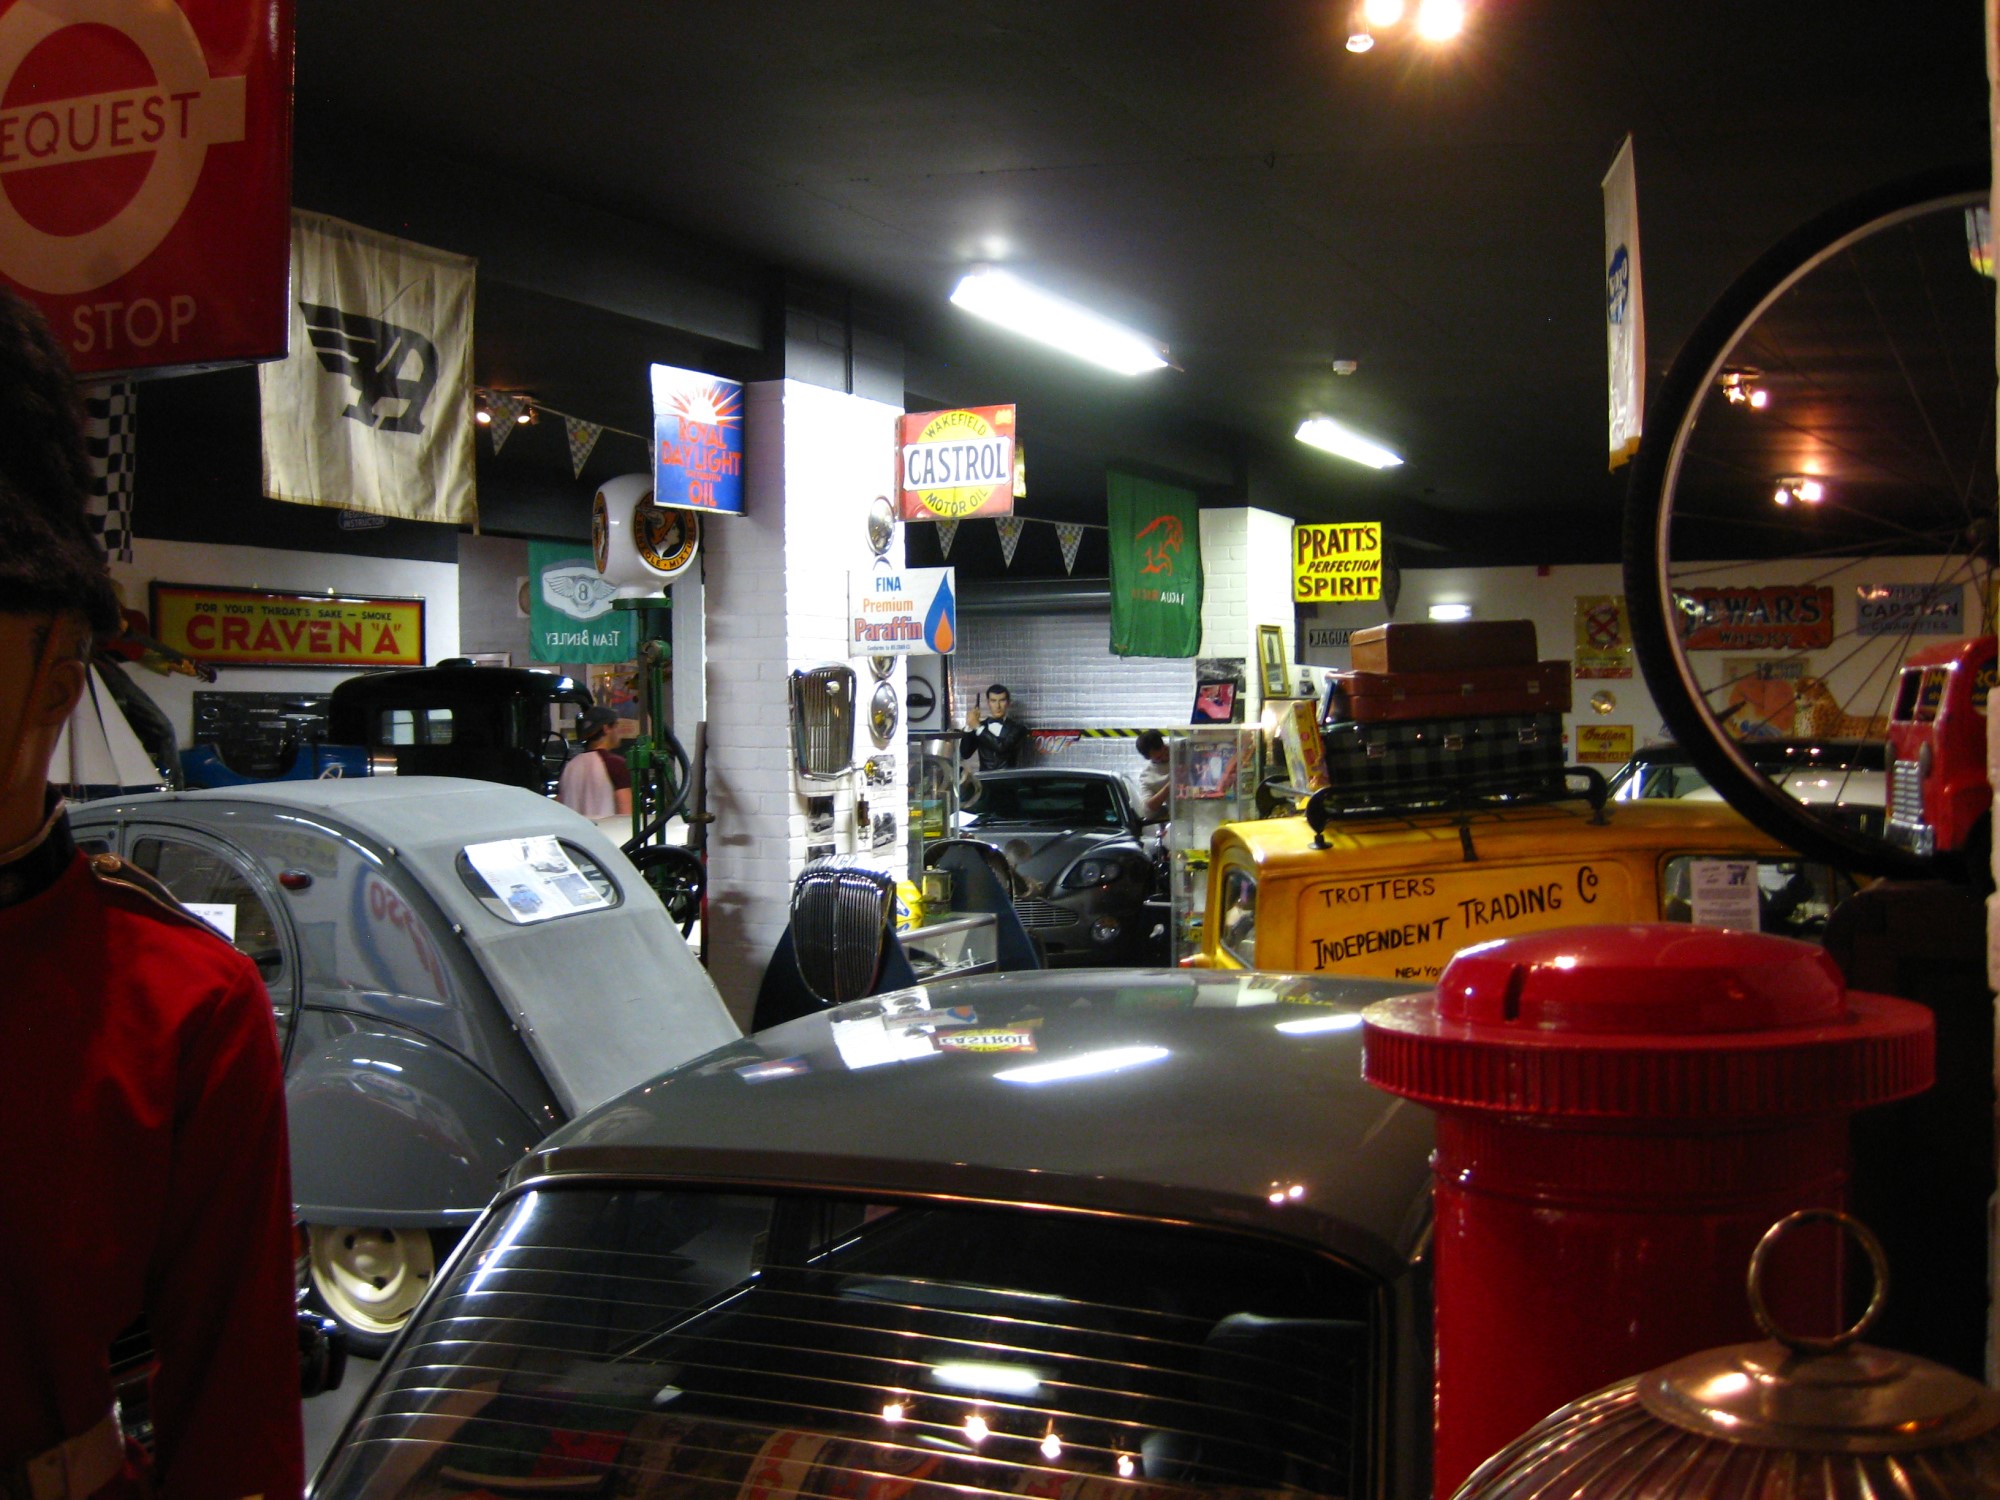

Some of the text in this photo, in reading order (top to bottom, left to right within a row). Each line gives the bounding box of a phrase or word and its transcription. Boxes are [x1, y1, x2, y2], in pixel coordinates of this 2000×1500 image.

[0, 91, 200, 160] EQUEST
[72, 294, 197, 352] STOP
[677, 417, 727, 450] ROYAL
[926, 413, 987, 438] WAKEFIELD
[661, 440, 742, 476] DAYLIGHT
[908, 443, 1006, 485] CASTROL
[688, 480, 717, 507] OIL
[926, 488, 988, 516] MOTOR OIL
[1307, 559, 1381, 573] PERFECTION
[876, 576, 901, 592] FINA
[1297, 575, 1378, 597] SPIRIT
[195, 603, 392, 621] FOR YOUR THROAT'S SAKE SMOKE
[863, 598, 913, 613] Premium
[186, 615, 362, 655] CRAVEN
[855, 616, 923, 642] Paraffin
[1315, 630, 1354, 646] JAGUA
[1720, 631, 1793, 645] WHISKY
[1035, 735, 1080, 754] 007
[1582, 728, 1626, 742] Indian
[1319, 877, 1435, 908] TROTTERS
[1311, 917, 1450, 970] INDEPENDENT
[1458, 883, 1563, 929] TRADING
[1395, 966, 1443, 979] NEW YO
